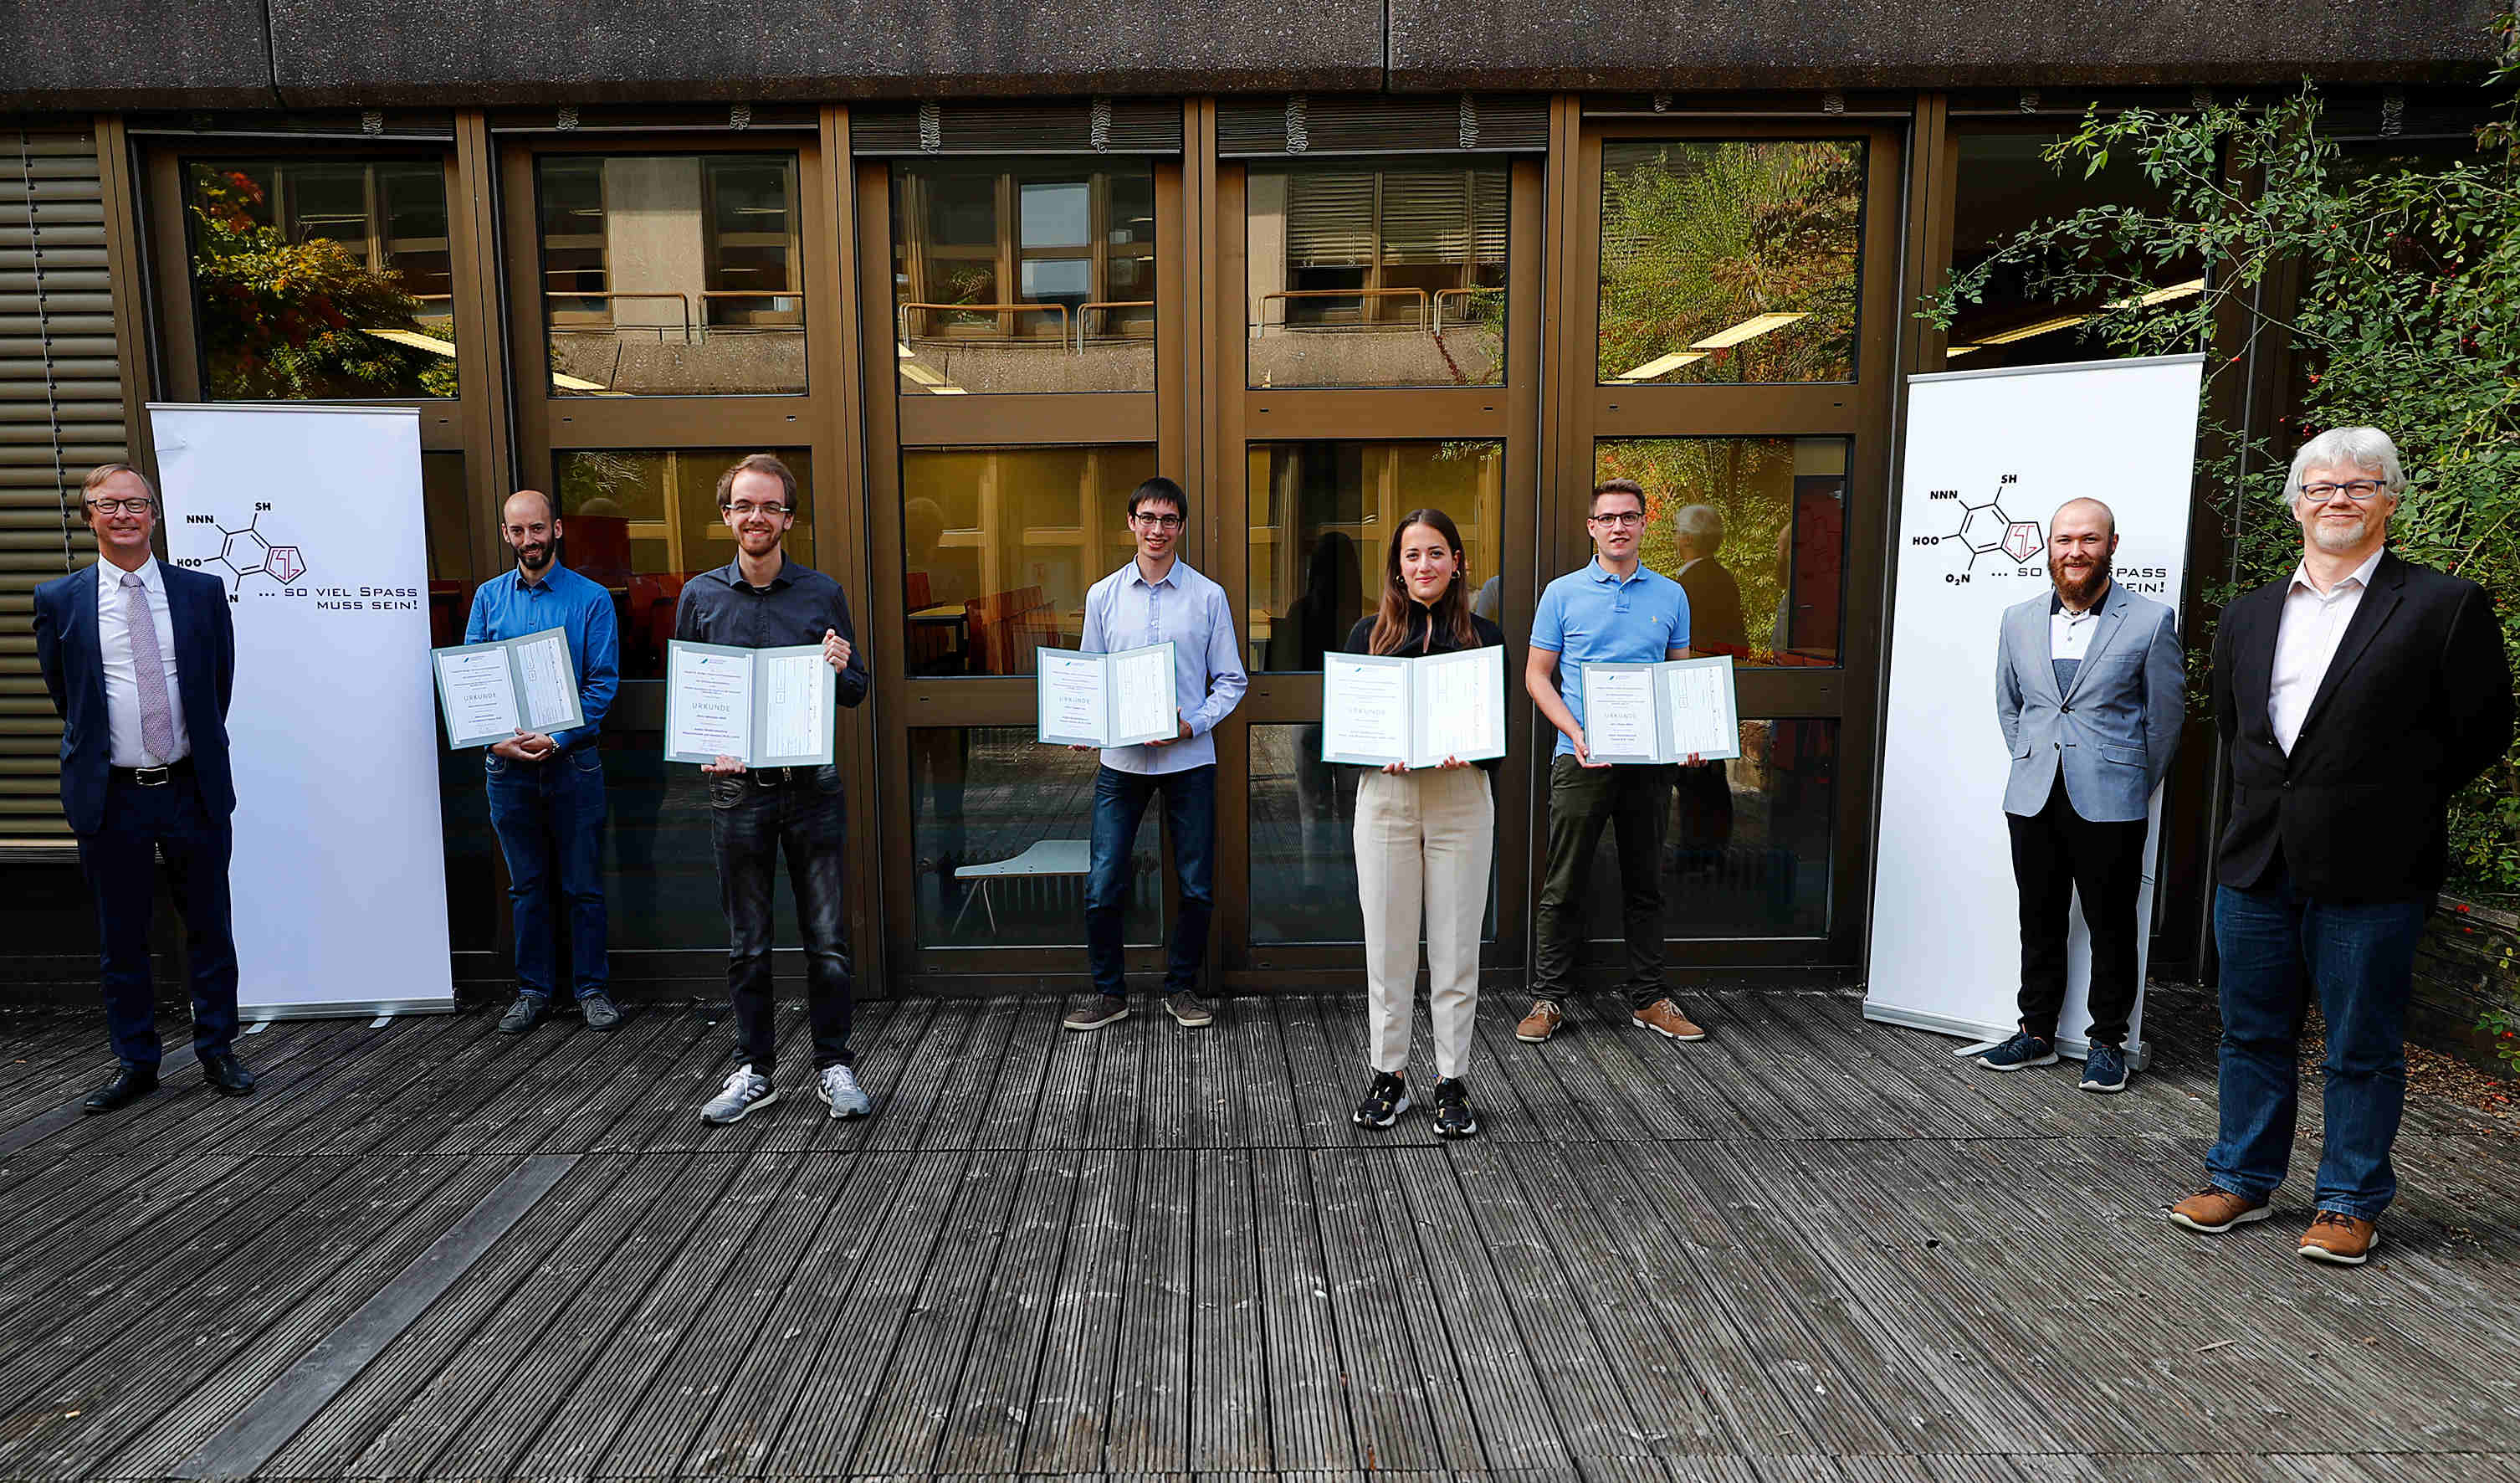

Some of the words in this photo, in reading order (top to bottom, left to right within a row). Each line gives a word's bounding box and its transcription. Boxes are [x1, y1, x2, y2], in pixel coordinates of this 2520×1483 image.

[2001, 475, 2017, 484] SH
[1930, 490, 1958, 500] NNN
[255, 502, 271, 511] SH
[187, 516, 214, 524] NNN
[1913, 536, 1939, 546] HOO
[177, 558, 202, 567] HOO
[2017, 567, 2041, 577] SO
[284, 588, 308, 597] SO
[315, 588, 351, 597] VIEL
[360, 587, 417, 597] SPASS
[2118, 582, 2165, 593] EIN!
[317, 601, 363, 610] MUSS
[371, 599, 417, 610] SEIN!
